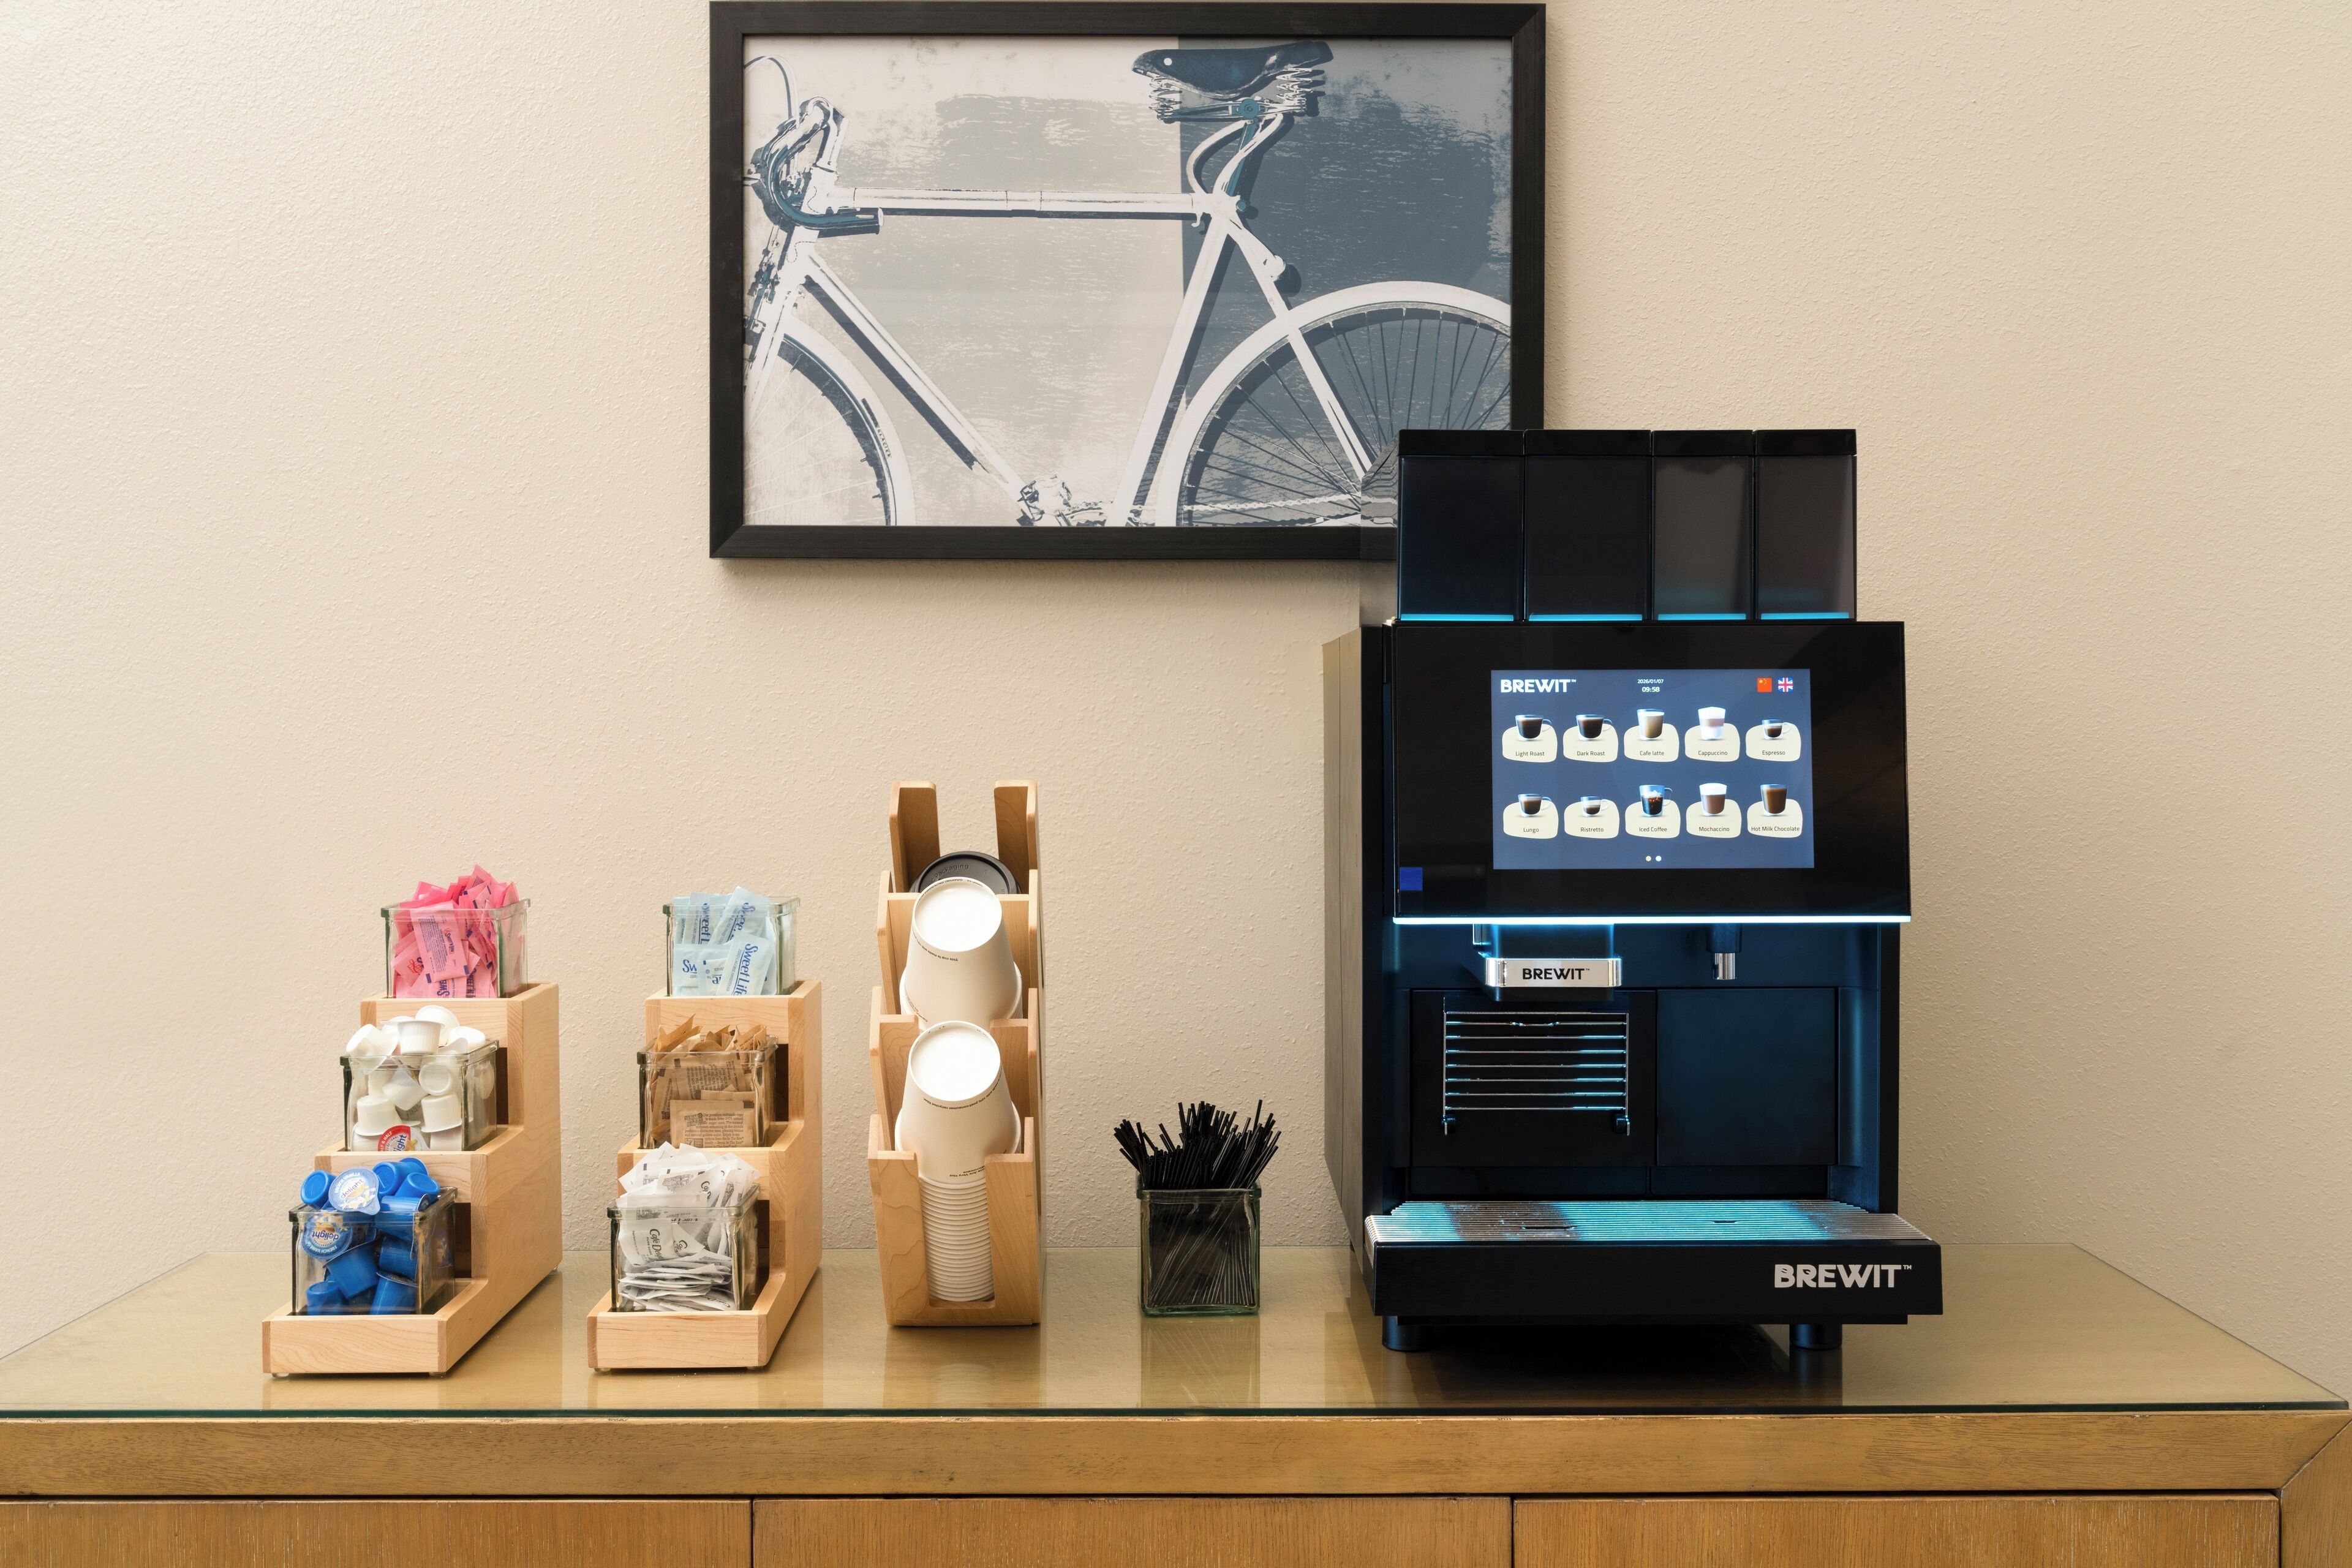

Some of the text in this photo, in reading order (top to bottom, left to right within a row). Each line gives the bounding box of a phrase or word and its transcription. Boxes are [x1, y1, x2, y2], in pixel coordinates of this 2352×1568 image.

[733, 943, 758, 995] Sweet Life
[949, 1101, 979, 1110] post-consumer
[383, 1131, 393, 1140] HALF
[341, 1178, 365, 1199] delight
[312, 1231, 339, 1241] delight
[649, 1229, 661, 1246] Café
[323, 1245, 337, 1254] FRENCH
